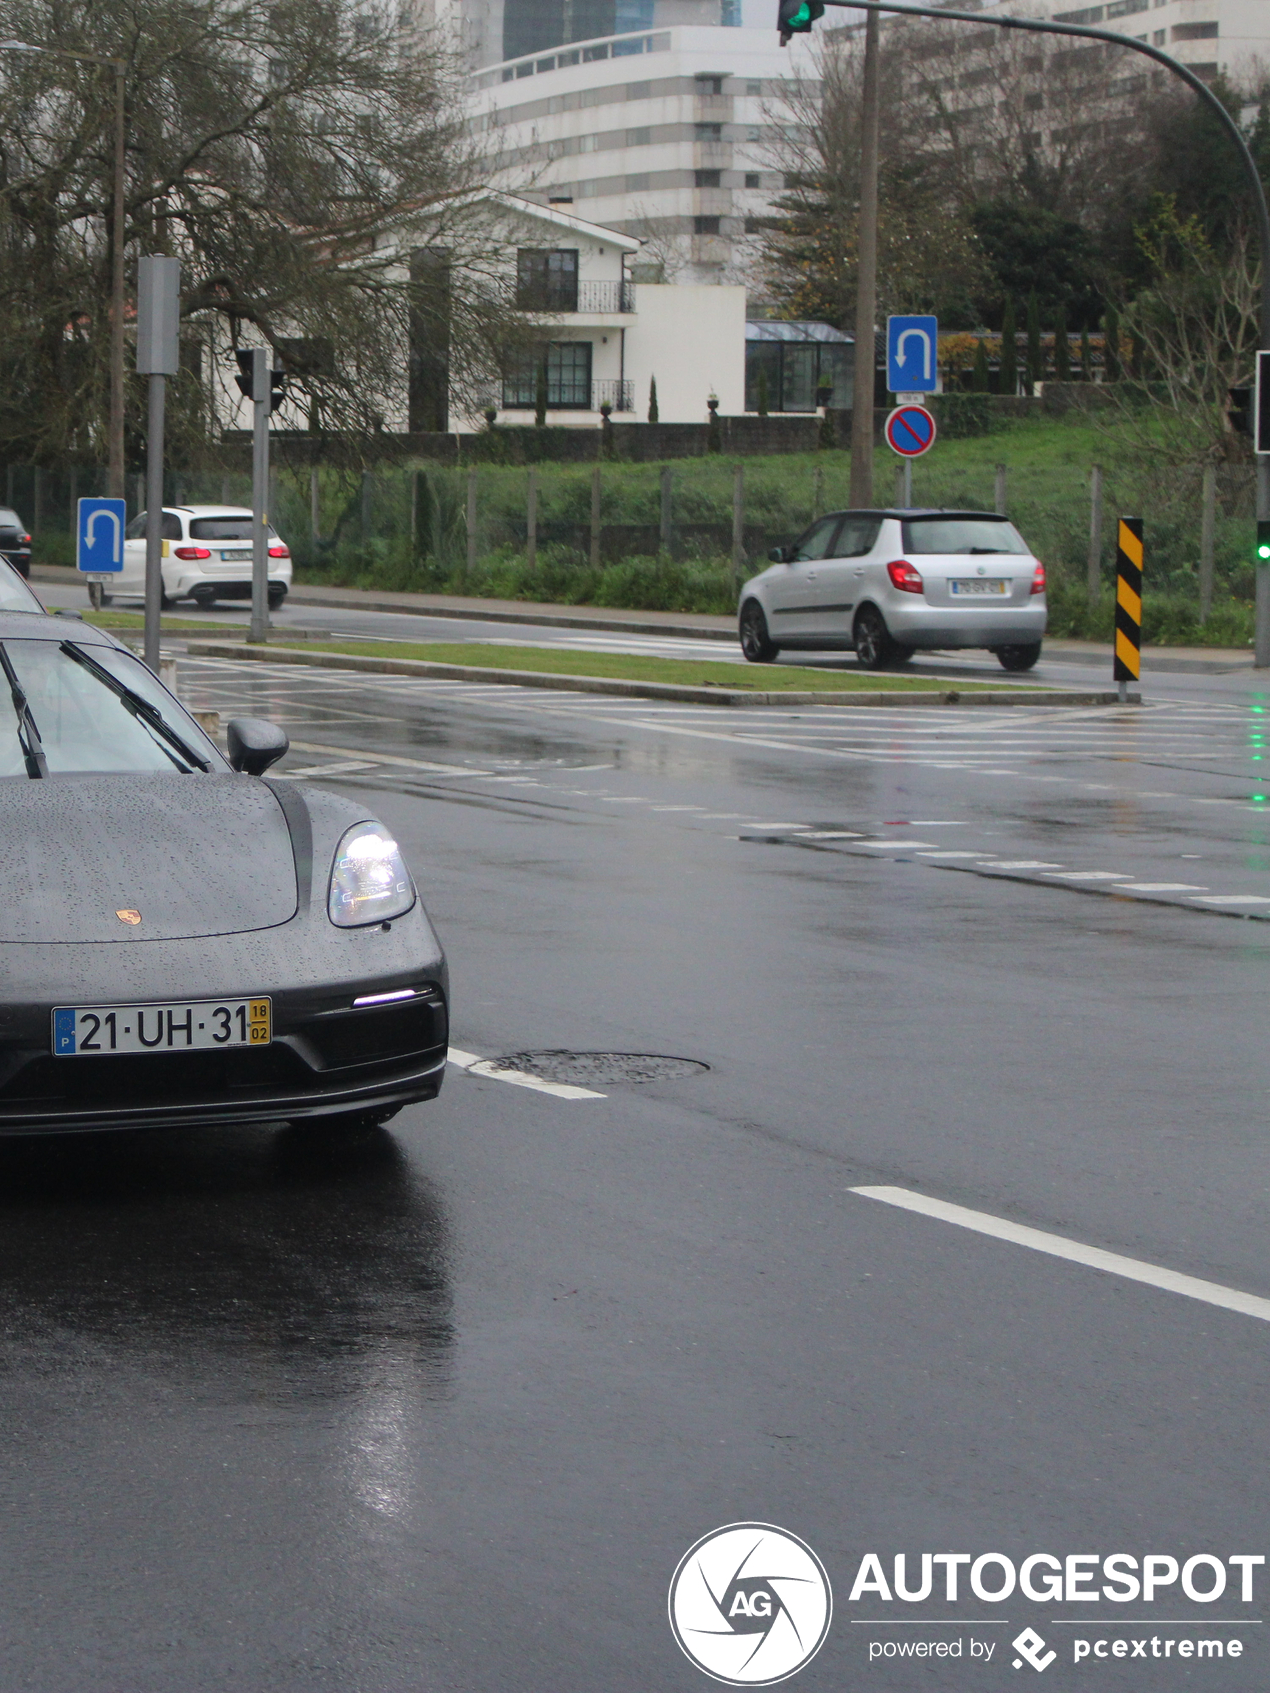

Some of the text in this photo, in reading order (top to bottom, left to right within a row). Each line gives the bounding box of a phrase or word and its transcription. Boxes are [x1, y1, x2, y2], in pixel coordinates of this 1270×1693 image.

[253, 1004, 267, 1017] 18
[252, 1028, 267, 1039] 02
[61, 1037, 70, 1048] P
